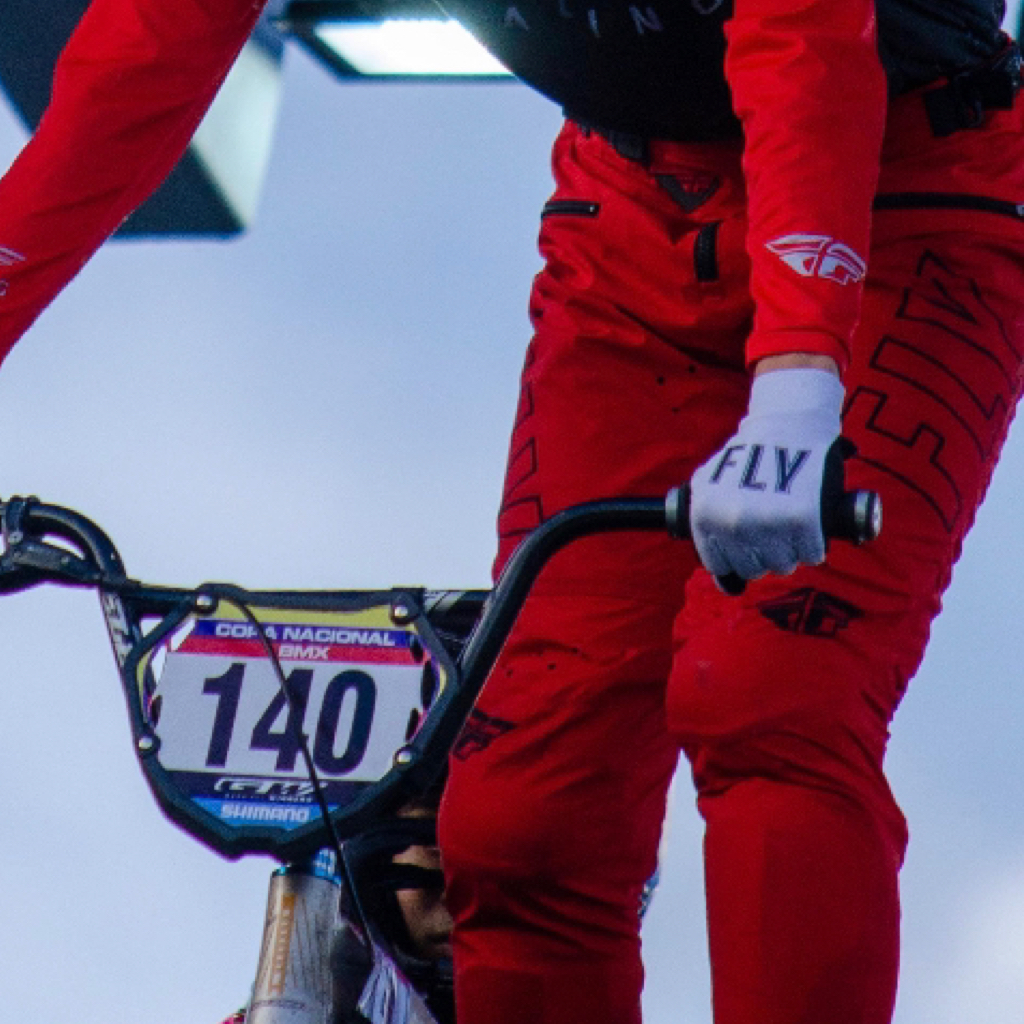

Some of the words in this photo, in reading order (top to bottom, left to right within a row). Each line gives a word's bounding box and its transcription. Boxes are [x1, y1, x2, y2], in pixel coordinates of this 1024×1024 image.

[708, 443, 812, 495] FLY
[215, 623, 277, 640] COPA
[282, 627, 396, 647] NACIONAL
[278, 644, 330, 660] BMX
[202, 662, 378, 776] 140
[220, 804, 310, 822] SHIMANO
